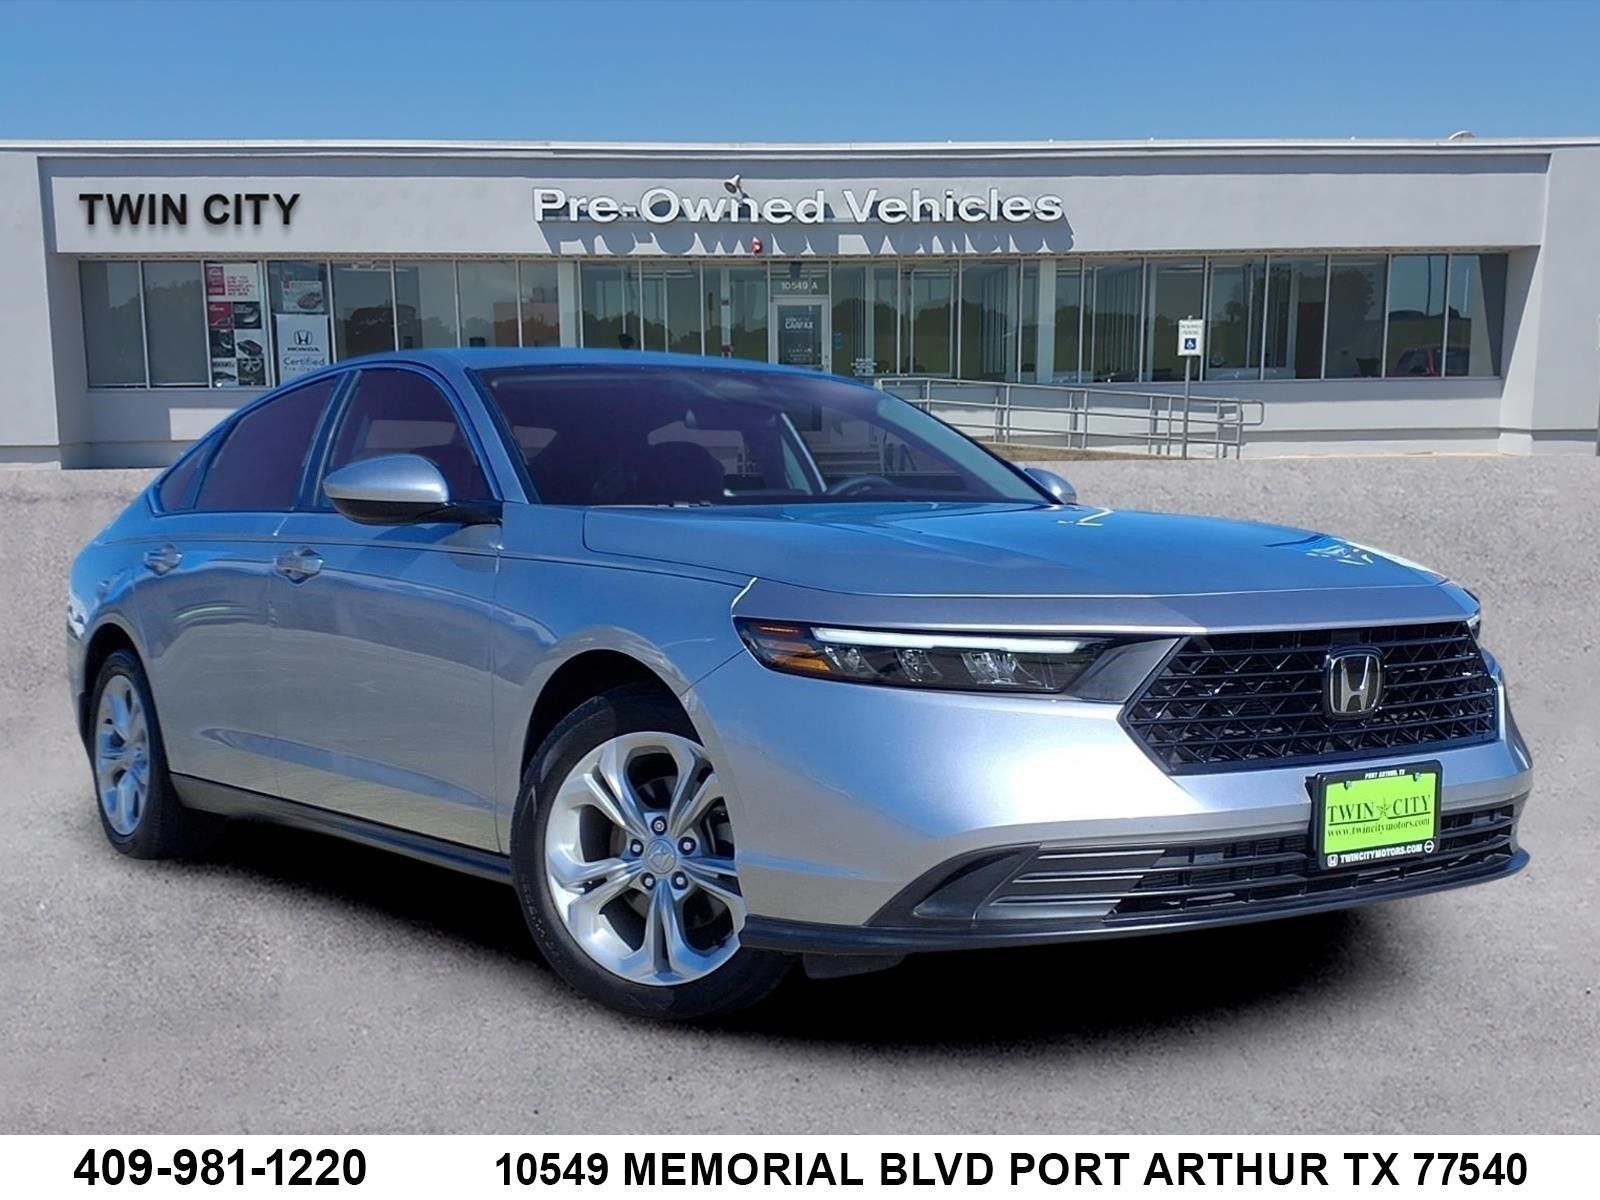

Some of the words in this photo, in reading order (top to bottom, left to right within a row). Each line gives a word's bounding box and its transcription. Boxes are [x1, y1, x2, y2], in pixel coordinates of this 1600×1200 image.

[79, 193, 187, 225] TWIN
[203, 193, 300, 225] CITY
[533, 188, 824, 223] Pre-Owned
[843, 188, 1063, 223] Vehicles
[1327, 801, 1375, 823] TWIN
[1392, 794, 1431, 816] CITY
[1327, 817, 1430, 838] www.twincitymotors.com
[1340, 843, 1423, 864] TWINCITYMOTORS.COM
